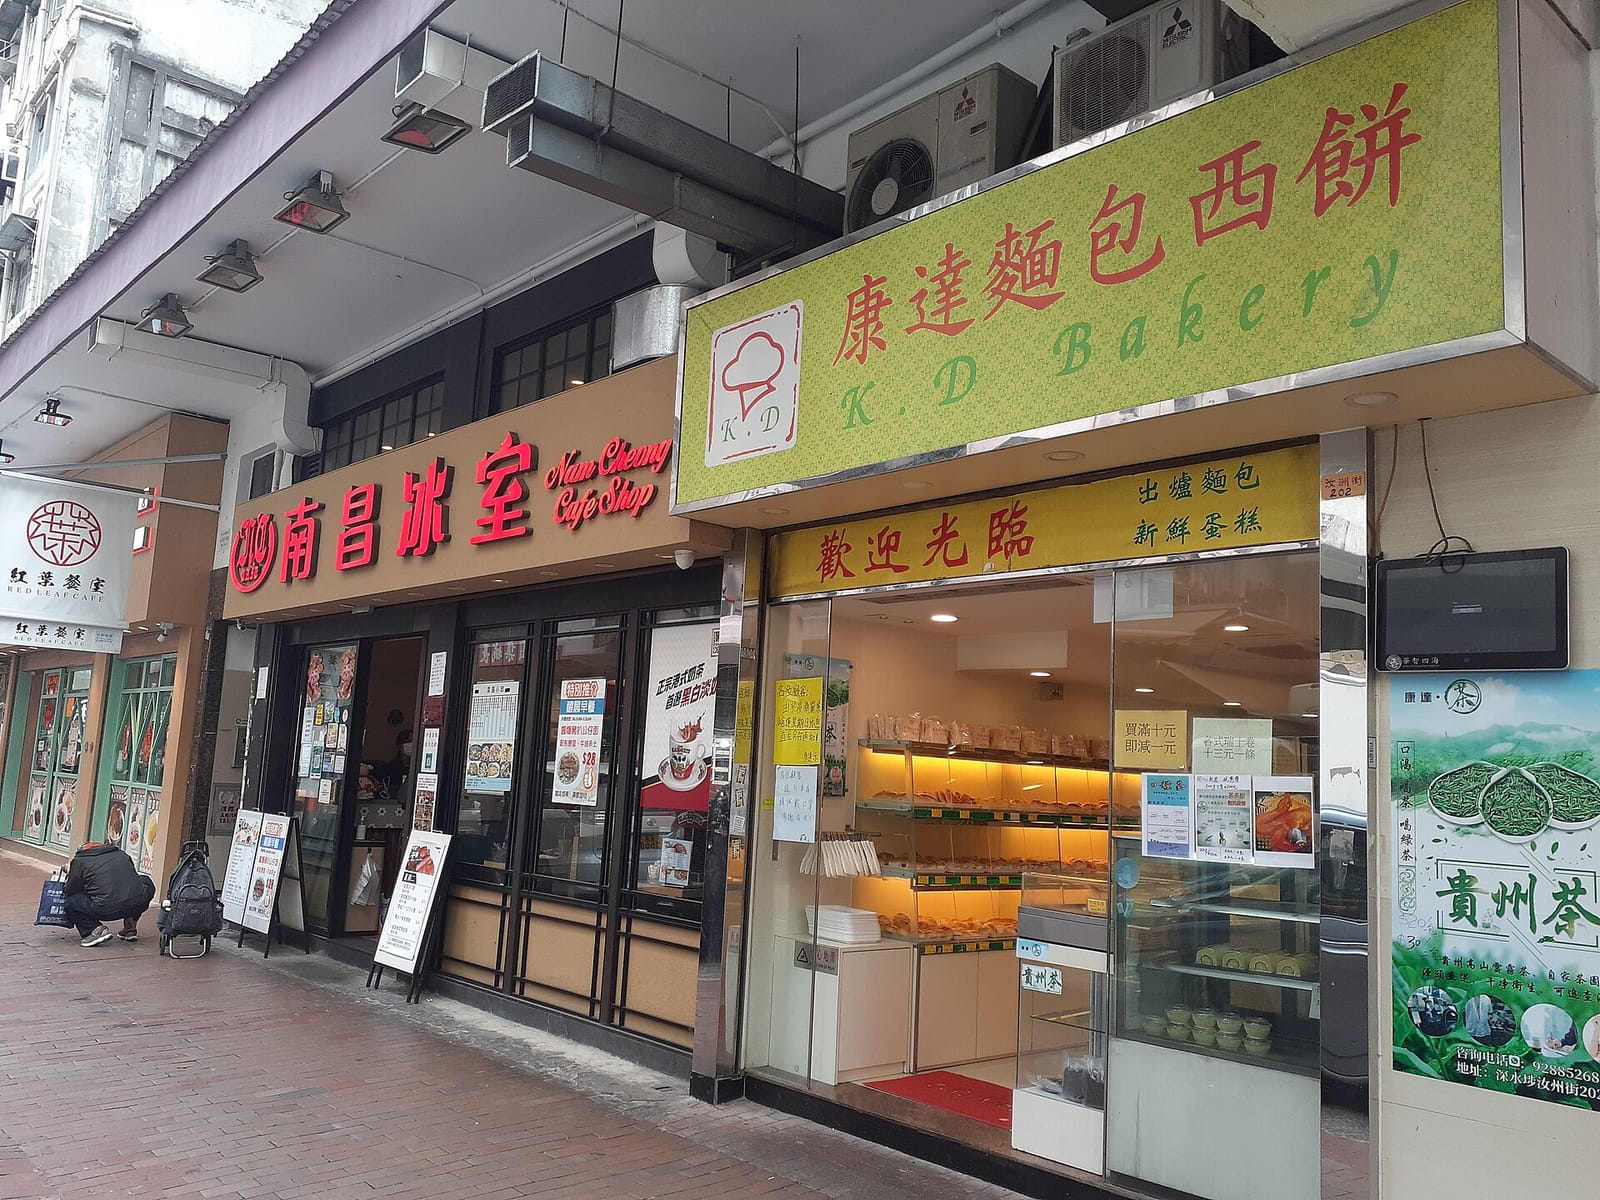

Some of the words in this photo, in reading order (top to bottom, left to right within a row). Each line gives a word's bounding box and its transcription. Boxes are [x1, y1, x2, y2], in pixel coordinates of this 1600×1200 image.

[832, 82, 1423, 367] 康達麵包西餅
[1053, 249, 1398, 377] Bakery
[544, 449, 597, 489] Nam
[598, 437, 672, 473] Cheong
[599, 475, 655, 518] Shop
[1138, 461, 1261, 505] 出爐麵包
[1330, 487, 1352, 498] 202
[280, 431, 533, 583] 南昌冰室
[1133, 506, 1263, 548] 新鮮蛋糕
[815, 500, 1035, 584] 歡迎光臨
[7, 585, 32, 595] RED
[36, 589, 69, 599] LEAF
[72, 593, 105, 603] CAFE
[10, 567, 106, 594] 紅葉餐室
[15, 622, 86, 641] 紅葉餐室
[566, 681, 599, 698] 特別推介
[656, 662, 705, 696] 正宗港式奶茶
[1125, 722, 1176, 738] 買滿十元
[1203, 736, 1256, 748] 各式瑞士卷
[582, 752, 597, 766] $28
[1203, 748, 1256, 760] 十三元一條
[1435, 868, 1600, 939] 貴州茶
[1022, 967, 1062, 990] 貴州茶
[1533, 1060, 1600, 1083] 92885268
